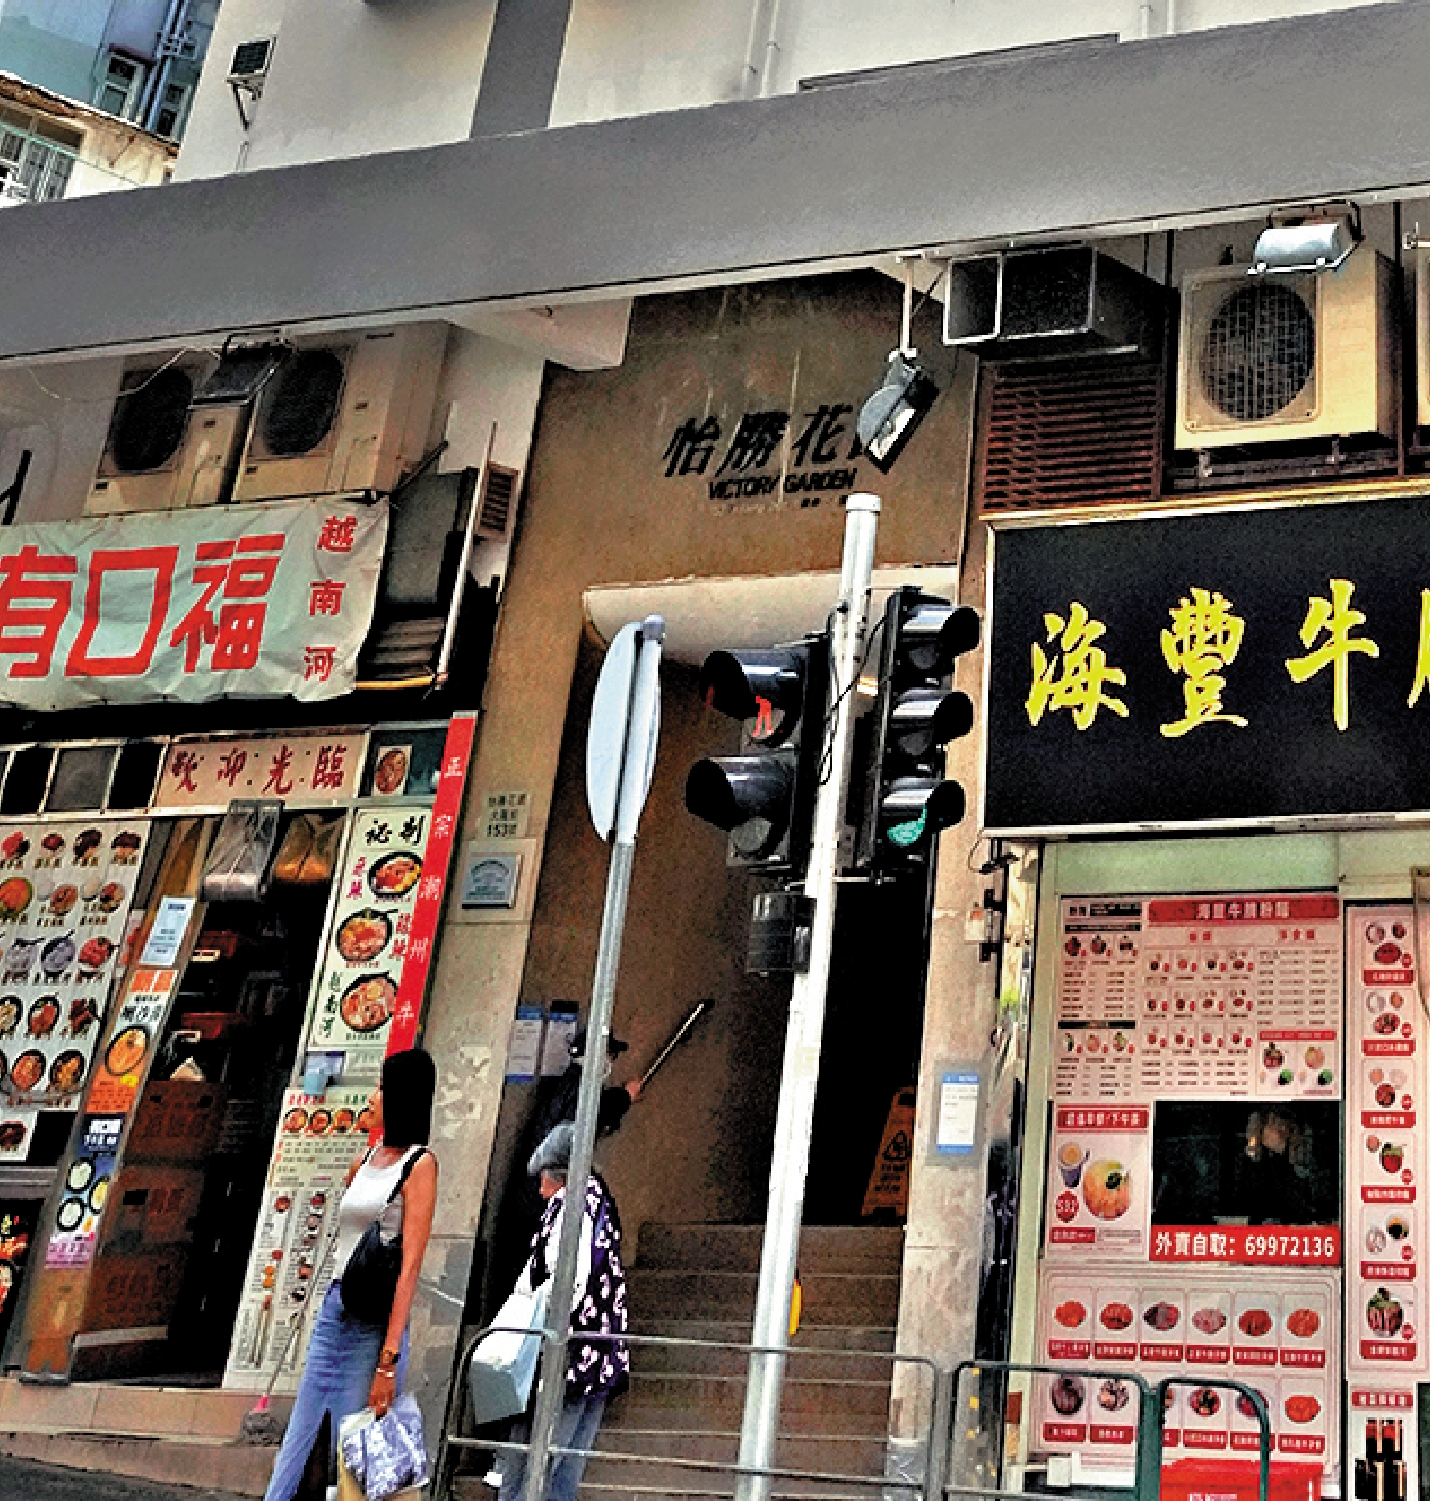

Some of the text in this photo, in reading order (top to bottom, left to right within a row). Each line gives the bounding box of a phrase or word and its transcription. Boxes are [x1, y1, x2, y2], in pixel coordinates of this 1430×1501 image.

[663, 404, 866, 478] 怡勝花
[708, 468, 858, 500] VICTORY GARDEN
[0, 533, 286, 680] 有口福
[304, 515, 359, 683] 越南河
[1245, 1235, 1335, 1258] 69972136
